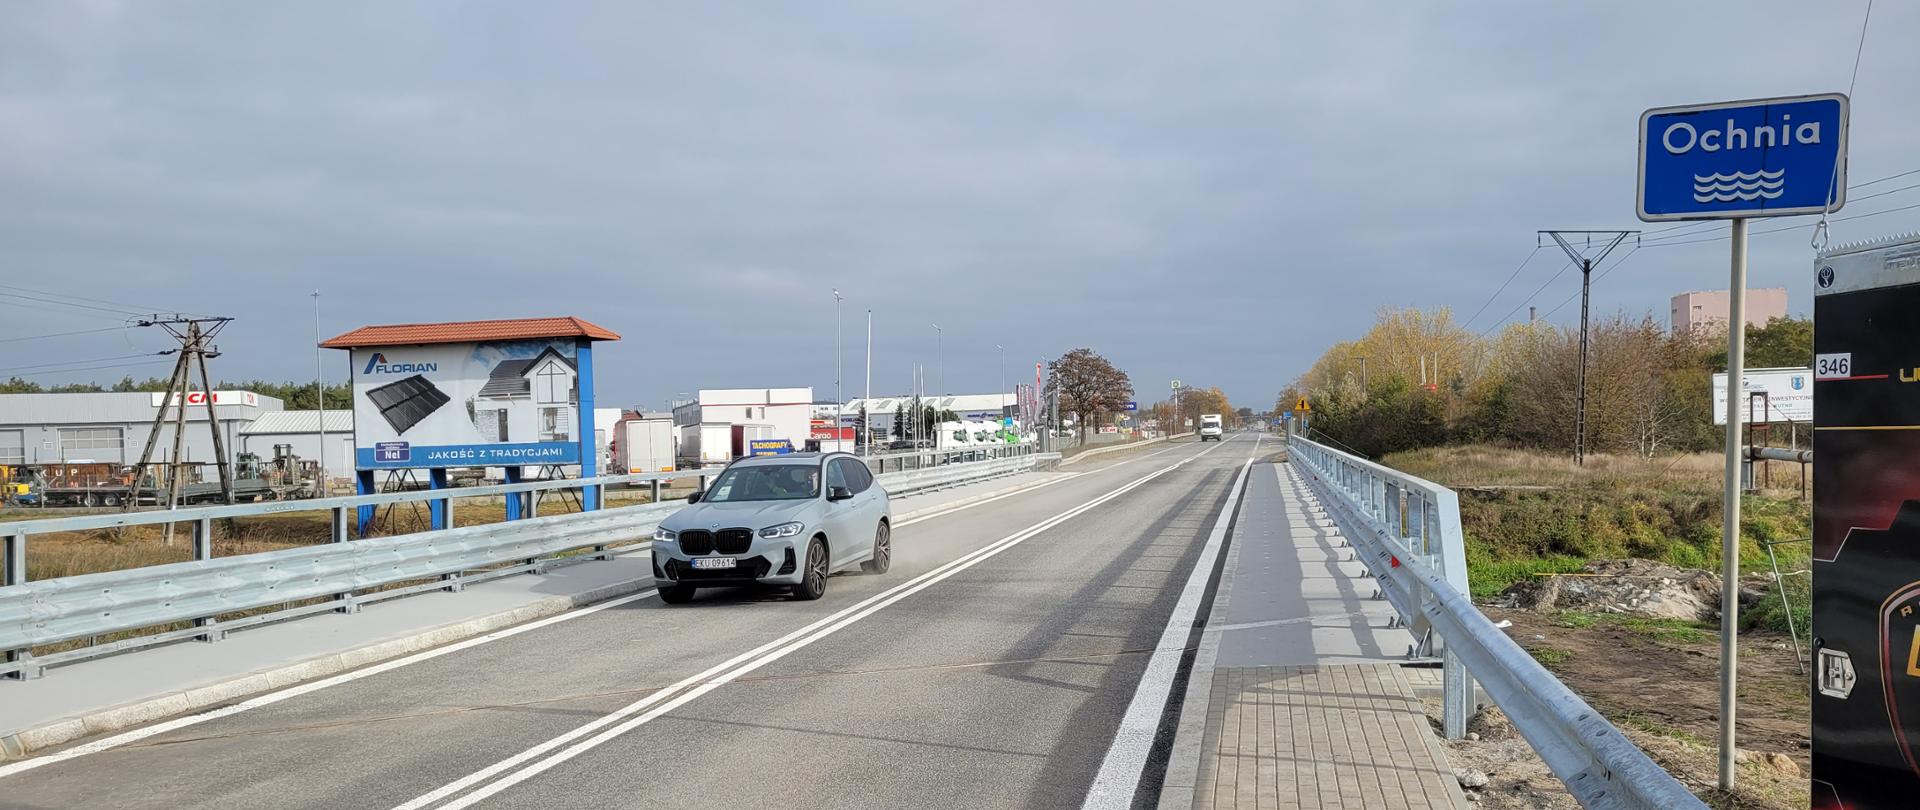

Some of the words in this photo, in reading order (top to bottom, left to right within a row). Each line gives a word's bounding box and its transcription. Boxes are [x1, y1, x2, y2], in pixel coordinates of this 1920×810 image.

[1662, 114, 1821, 154] Ochnia
[376, 363, 437, 374] FLORIAN
[1819, 358, 1849, 375] 346
[428, 449, 474, 459] JAKOŚĆ
[490, 447, 562, 457] TRADYCJAMI
[696, 560, 710, 568] EKU
[712, 559, 736, 567] 09614
